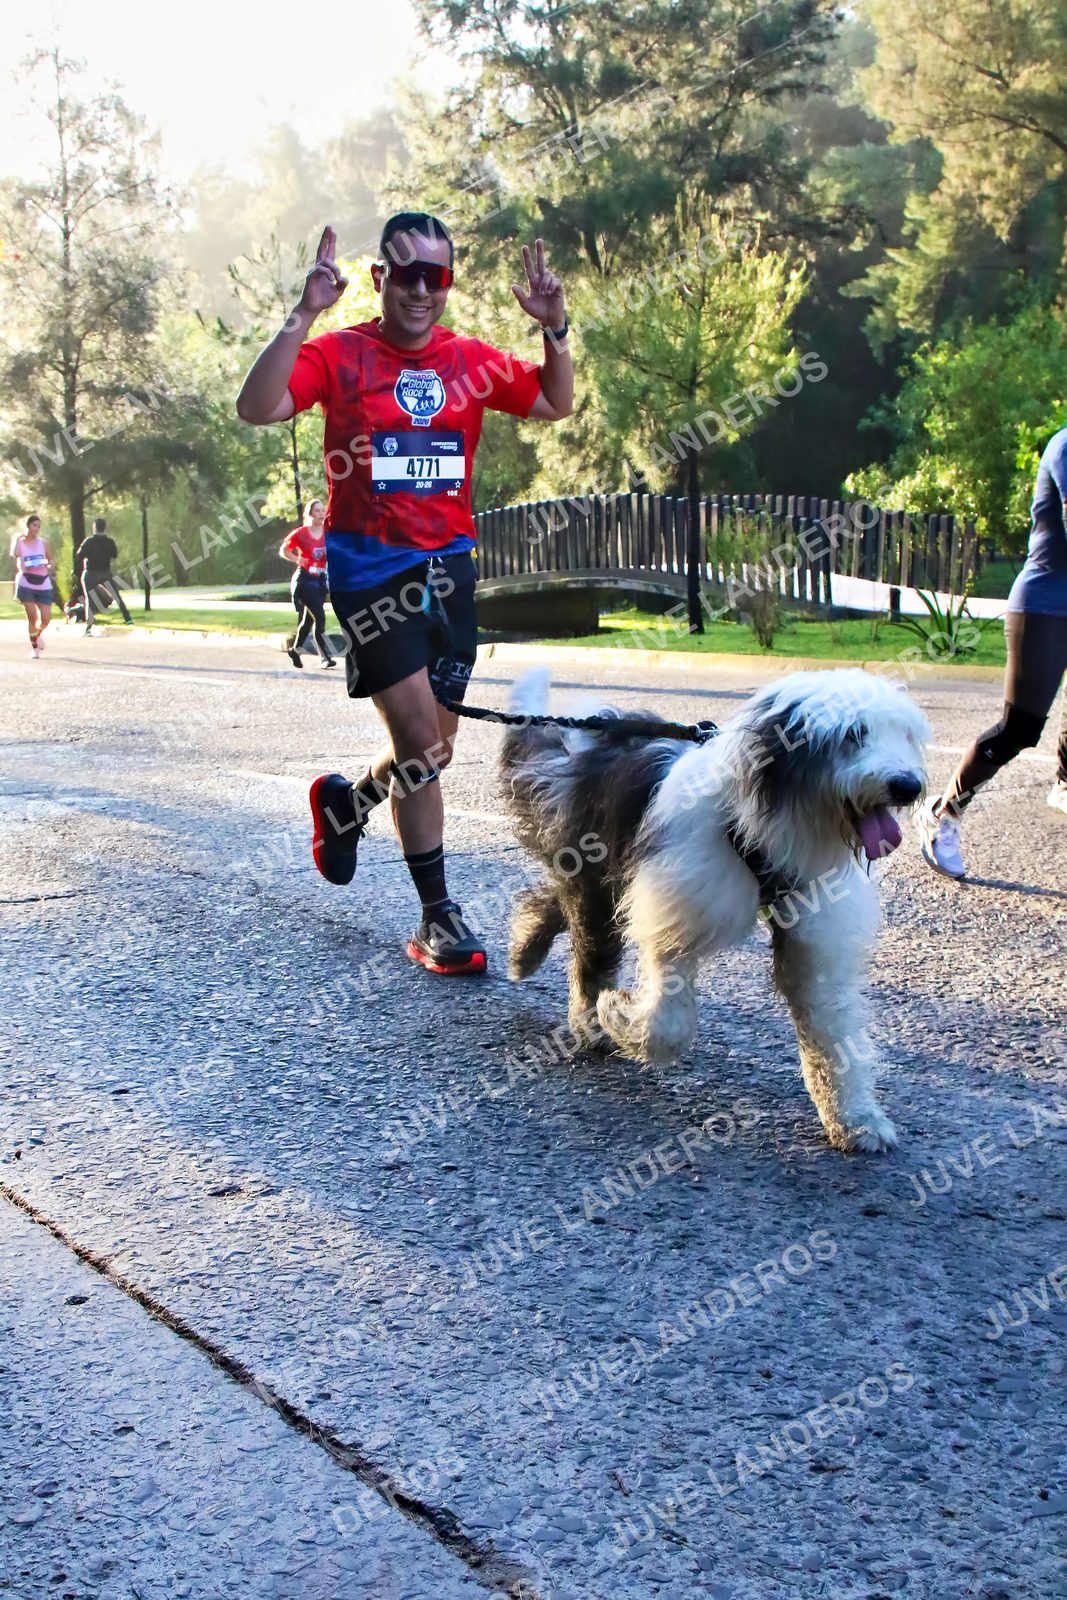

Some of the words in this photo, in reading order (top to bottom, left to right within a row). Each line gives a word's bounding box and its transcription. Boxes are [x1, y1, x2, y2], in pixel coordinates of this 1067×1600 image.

[408, 379, 434, 389] Global
[402, 387, 424, 397] Race
[406, 457, 440, 478] 4771
